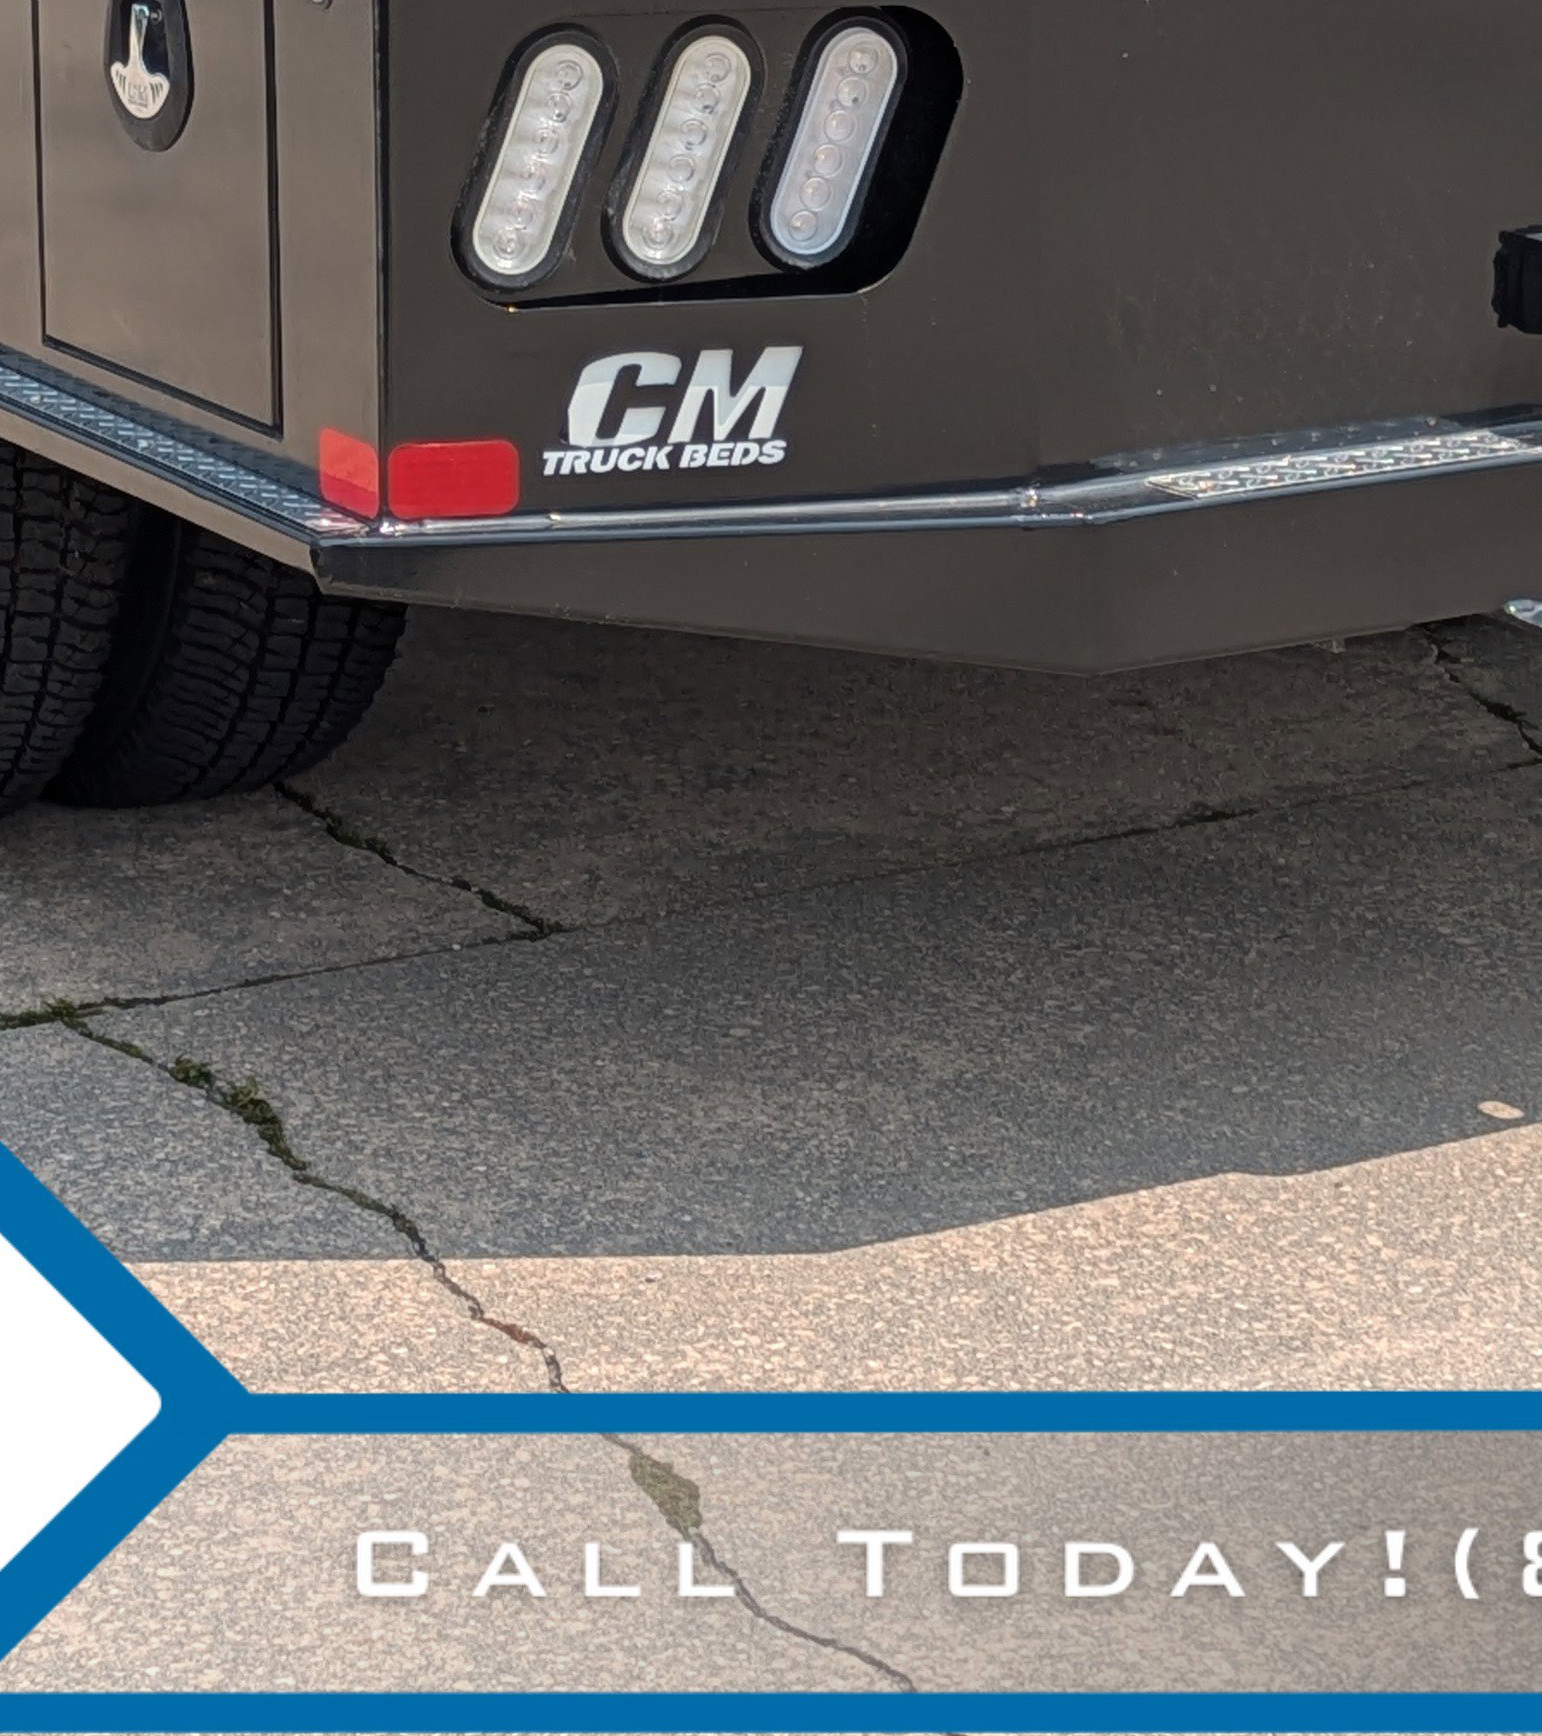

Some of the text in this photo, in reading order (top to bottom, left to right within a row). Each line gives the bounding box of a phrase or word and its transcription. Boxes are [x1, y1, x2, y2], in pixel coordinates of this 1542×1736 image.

[568, 346, 803, 448] CM
[542, 439, 788, 477] TRUCK BEDS
